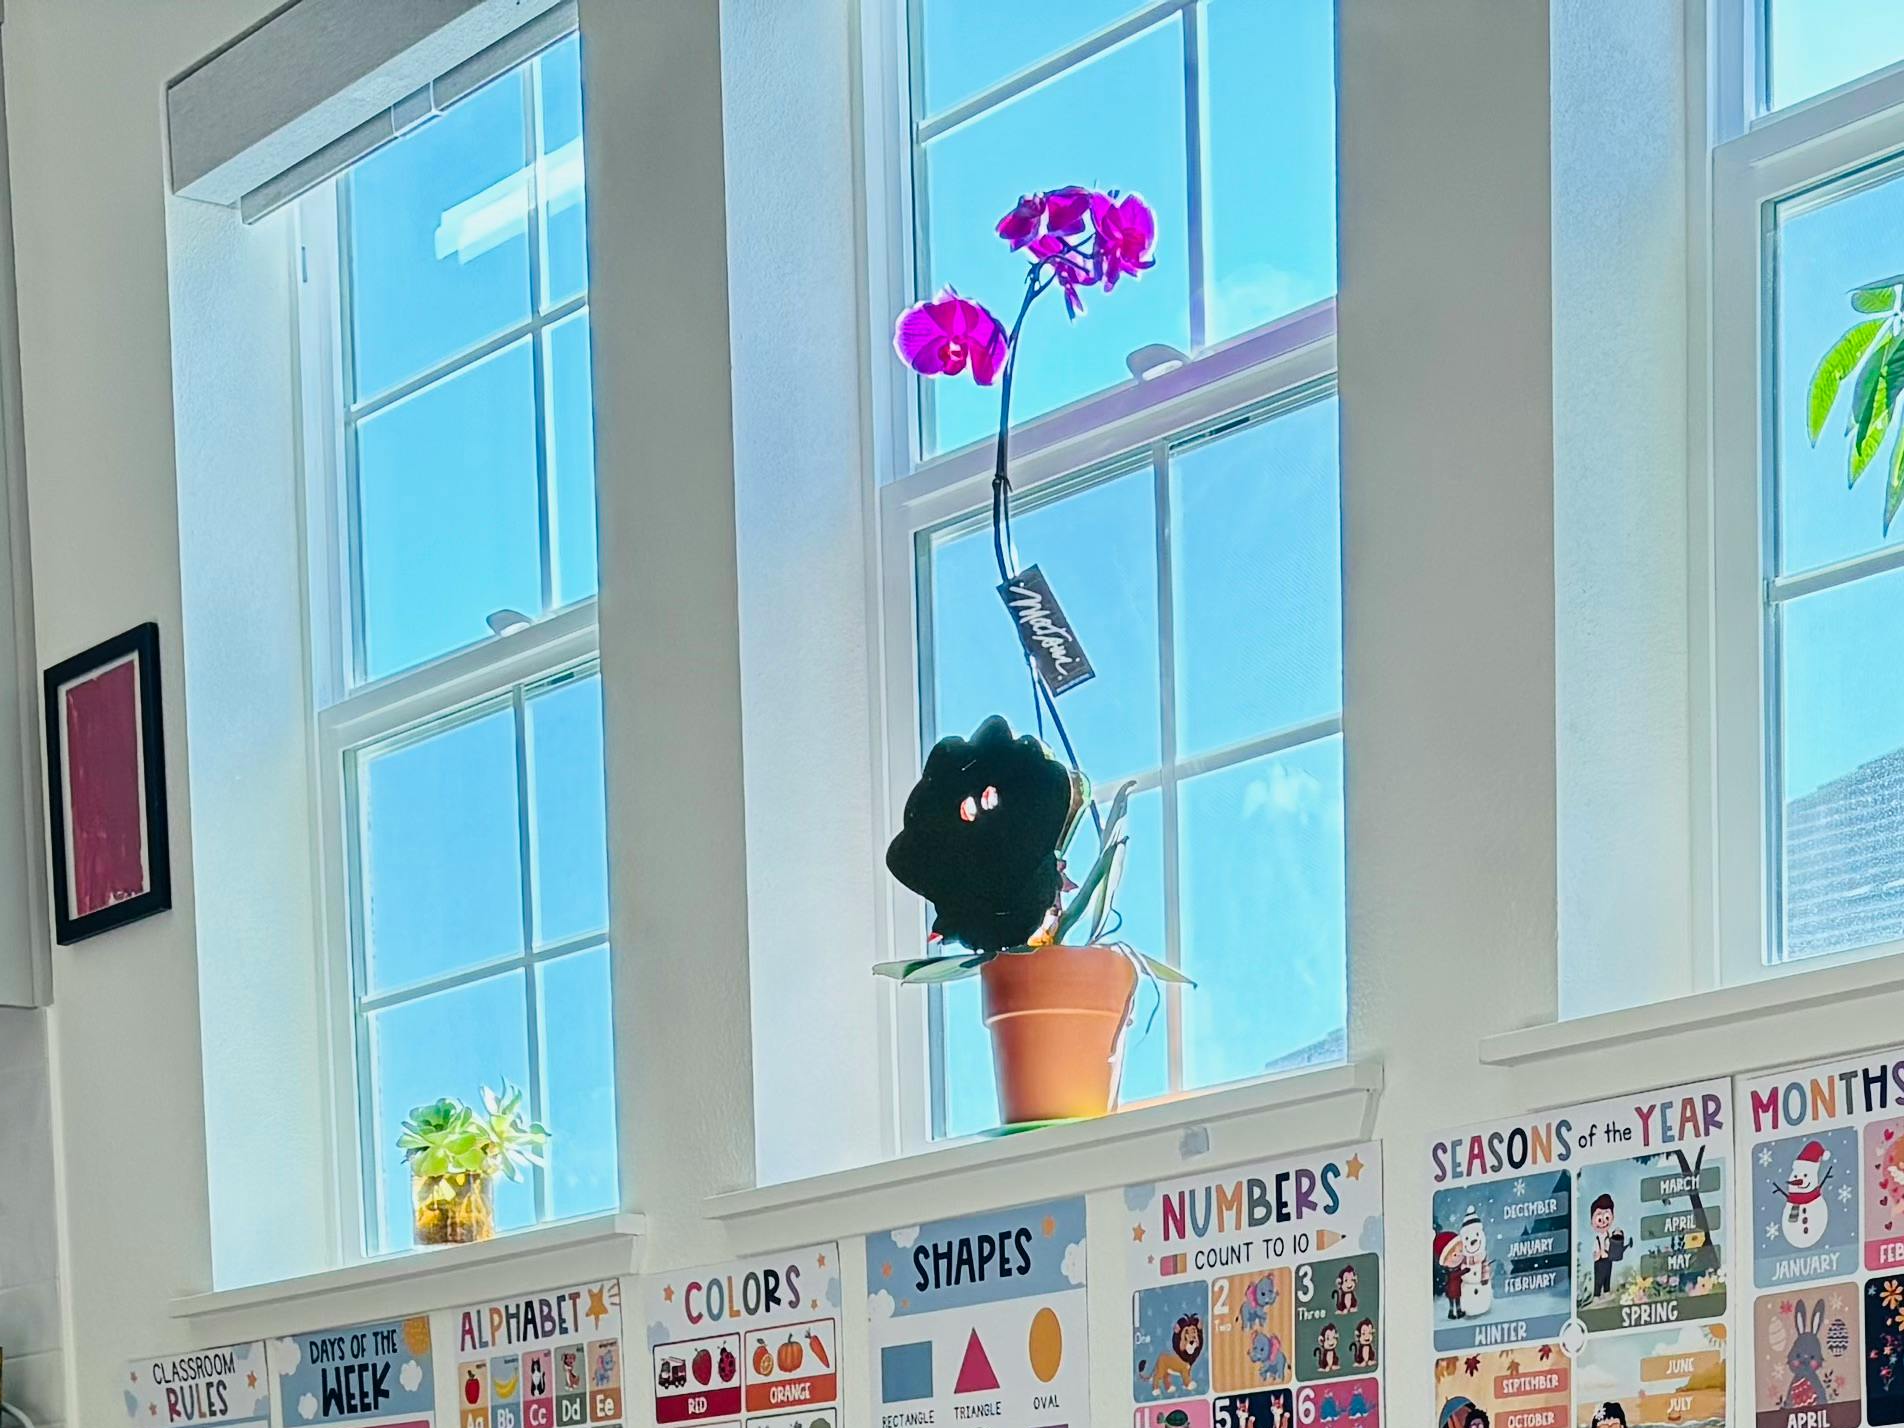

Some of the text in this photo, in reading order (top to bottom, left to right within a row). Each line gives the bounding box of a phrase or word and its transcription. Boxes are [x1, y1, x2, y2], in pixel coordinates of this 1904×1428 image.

[1431, 1093, 1724, 1184] SEASONS of the YEAR
[1660, 1176, 1700, 1194] MARCH
[1162, 1163, 1341, 1242] NUMBERS
[1503, 1198, 1558, 1220] DECEMBER
[1664, 1214, 1696, 1233] APRIL
[913, 1227, 1033, 1292] SHAPES
[1195, 1241, 1254, 1270] COUNT
[1262, 1236, 1285, 1258] TO
[1508, 1237, 1554, 1258] JANUARY
[1667, 1254, 1692, 1271] MAY
[1771, 1252, 1841, 1281] JANUARY
[685, 1264, 801, 1325] COLORS
[1504, 1272, 1556, 1294] FEBRUARY
[460, 1291, 581, 1352] ALPHABET
[1621, 1300, 1678, 1328] SPRING
[1474, 1321, 1528, 1346] WINTER
[309, 1329, 397, 1364] DAYS OF THE
[153, 1351, 235, 1385] CLASSROOM
[1666, 1357, 1695, 1374] JUNE
[321, 1360, 391, 1417] WEEK
[1502, 1374, 1560, 1394] SEPTEMBER
[166, 1379, 228, 1423] RULES
[954, 1401, 1002, 1421] TRIANGLE
[1033, 1394, 1060, 1410] OVAL
[1666, 1396, 1694, 1414] JULY
[882, 1409, 935, 1428] RECTANGLE
